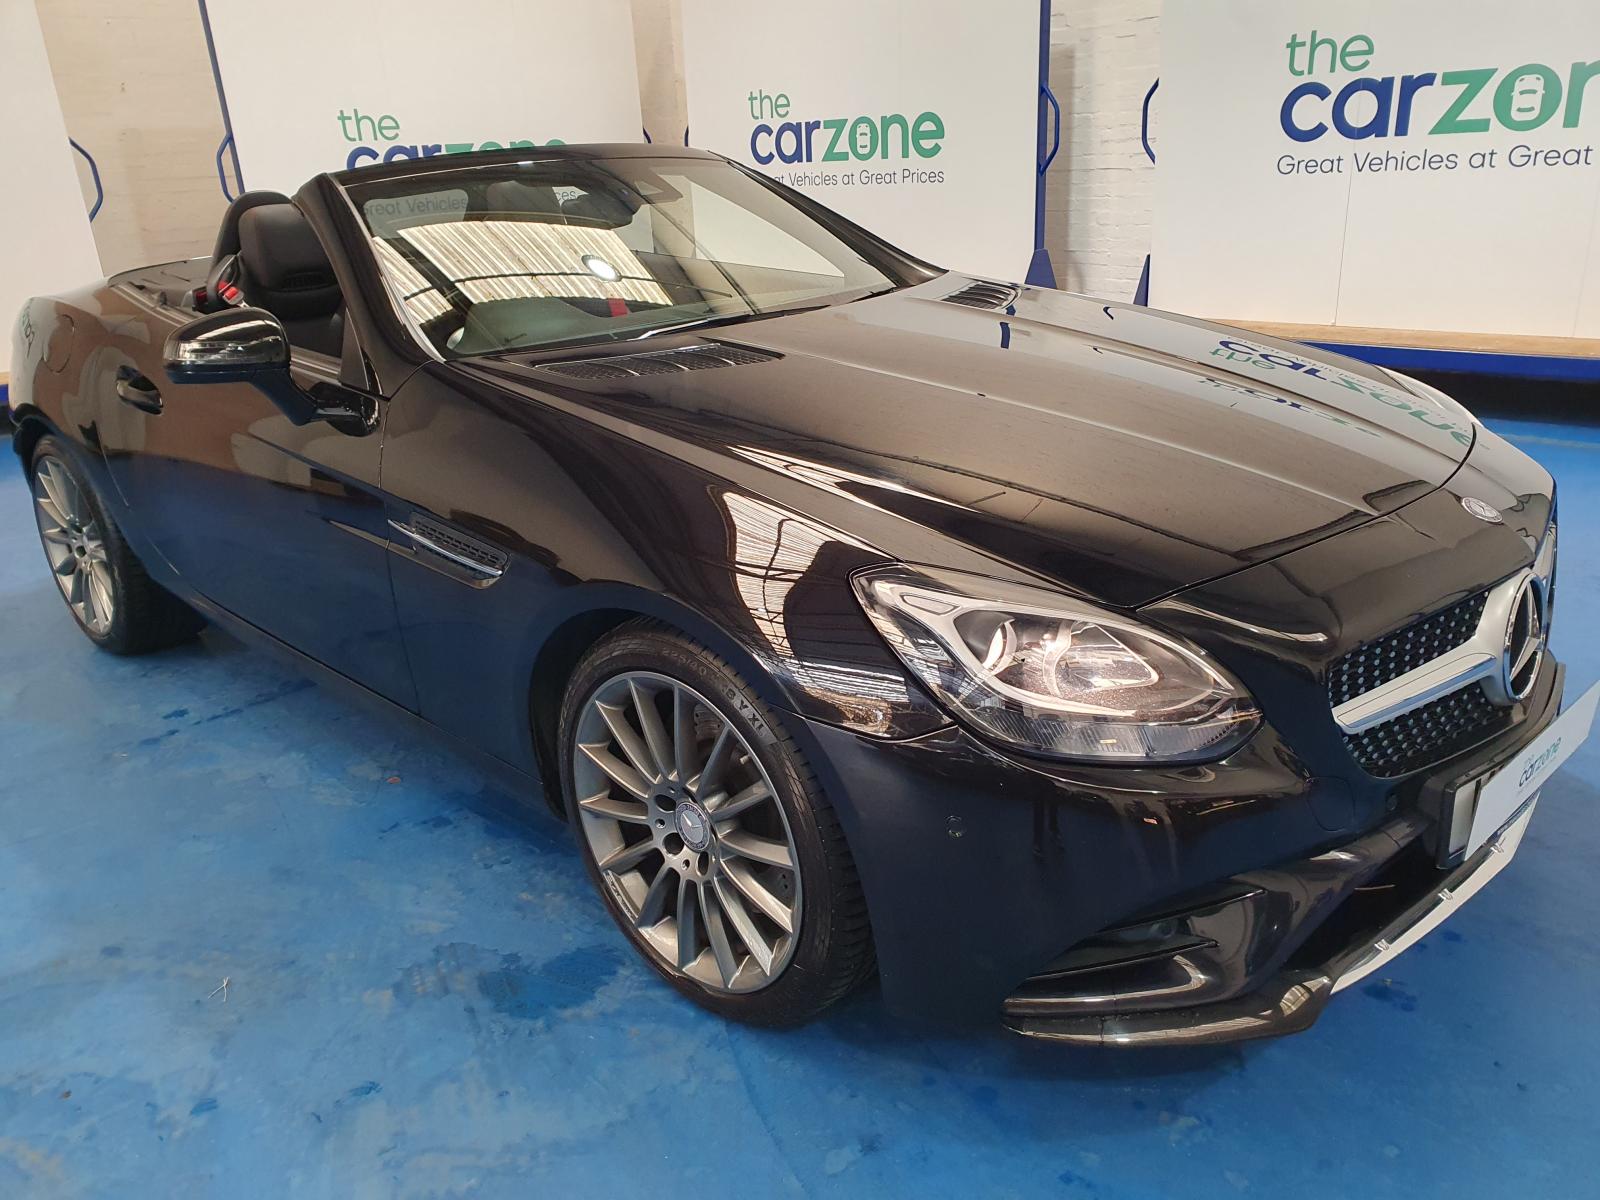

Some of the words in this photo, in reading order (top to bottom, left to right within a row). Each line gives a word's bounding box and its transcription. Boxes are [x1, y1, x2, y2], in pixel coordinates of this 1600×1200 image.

[1286, 30, 1374, 77] the
[748, 89, 790, 120] the
[337, 108, 400, 142] the
[750, 111, 945, 165] carzone
[1277, 154, 1344, 175] Great
[1354, 149, 1459, 173] Vehicles
[1469, 150, 1497, 170] at
[1508, 144, 1594, 167] Great
[789, 171, 838, 187] Vehicles
[842, 173, 855, 186] at
[859, 169, 897, 185] Great
[902, 168, 945, 184] Prices
[406, 195, 467, 214] Vehicles
